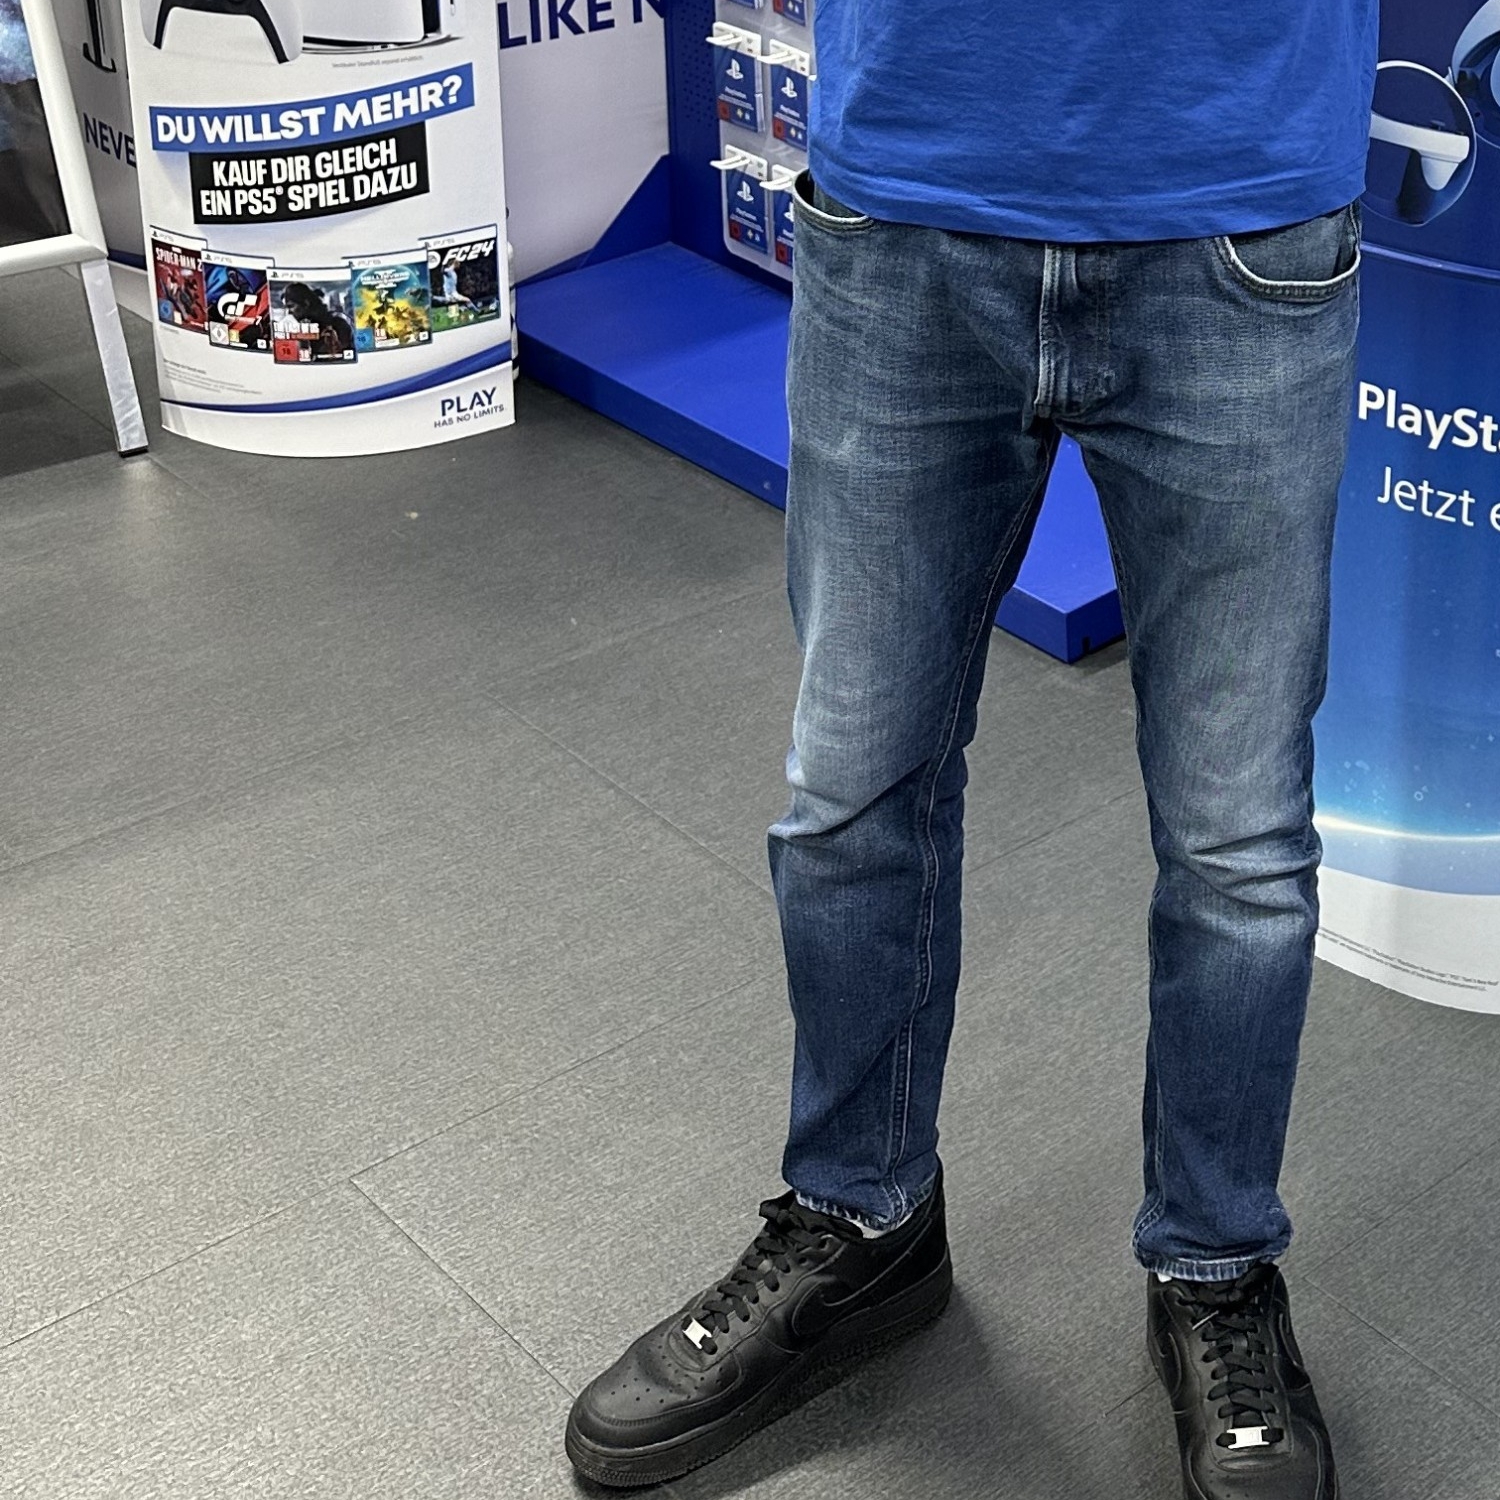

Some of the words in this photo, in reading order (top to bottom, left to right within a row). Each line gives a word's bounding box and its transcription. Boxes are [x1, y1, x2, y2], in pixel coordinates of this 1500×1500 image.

[156, 114, 196, 144] DU
[199, 106, 326, 144] WILLST
[333, 74, 463, 132] MEHR?
[83, 112, 137, 169] NEVE
[212, 158, 269, 187] KAUF
[271, 153, 311, 184] DIR
[315, 137, 397, 178] GLEICH
[200, 189, 232, 215] EIN
[288, 180, 350, 211] SPIEL
[353, 161, 417, 202] DAZU
[155, 247, 196, 270] SPIDER-MAN
[434, 417, 454, 428] HAS
[456, 413, 471, 423] NO
[473, 404, 504, 419] LIMITS
[441, 386, 497, 417] PLAY
[1376, 466, 1476, 527] Jetzt
